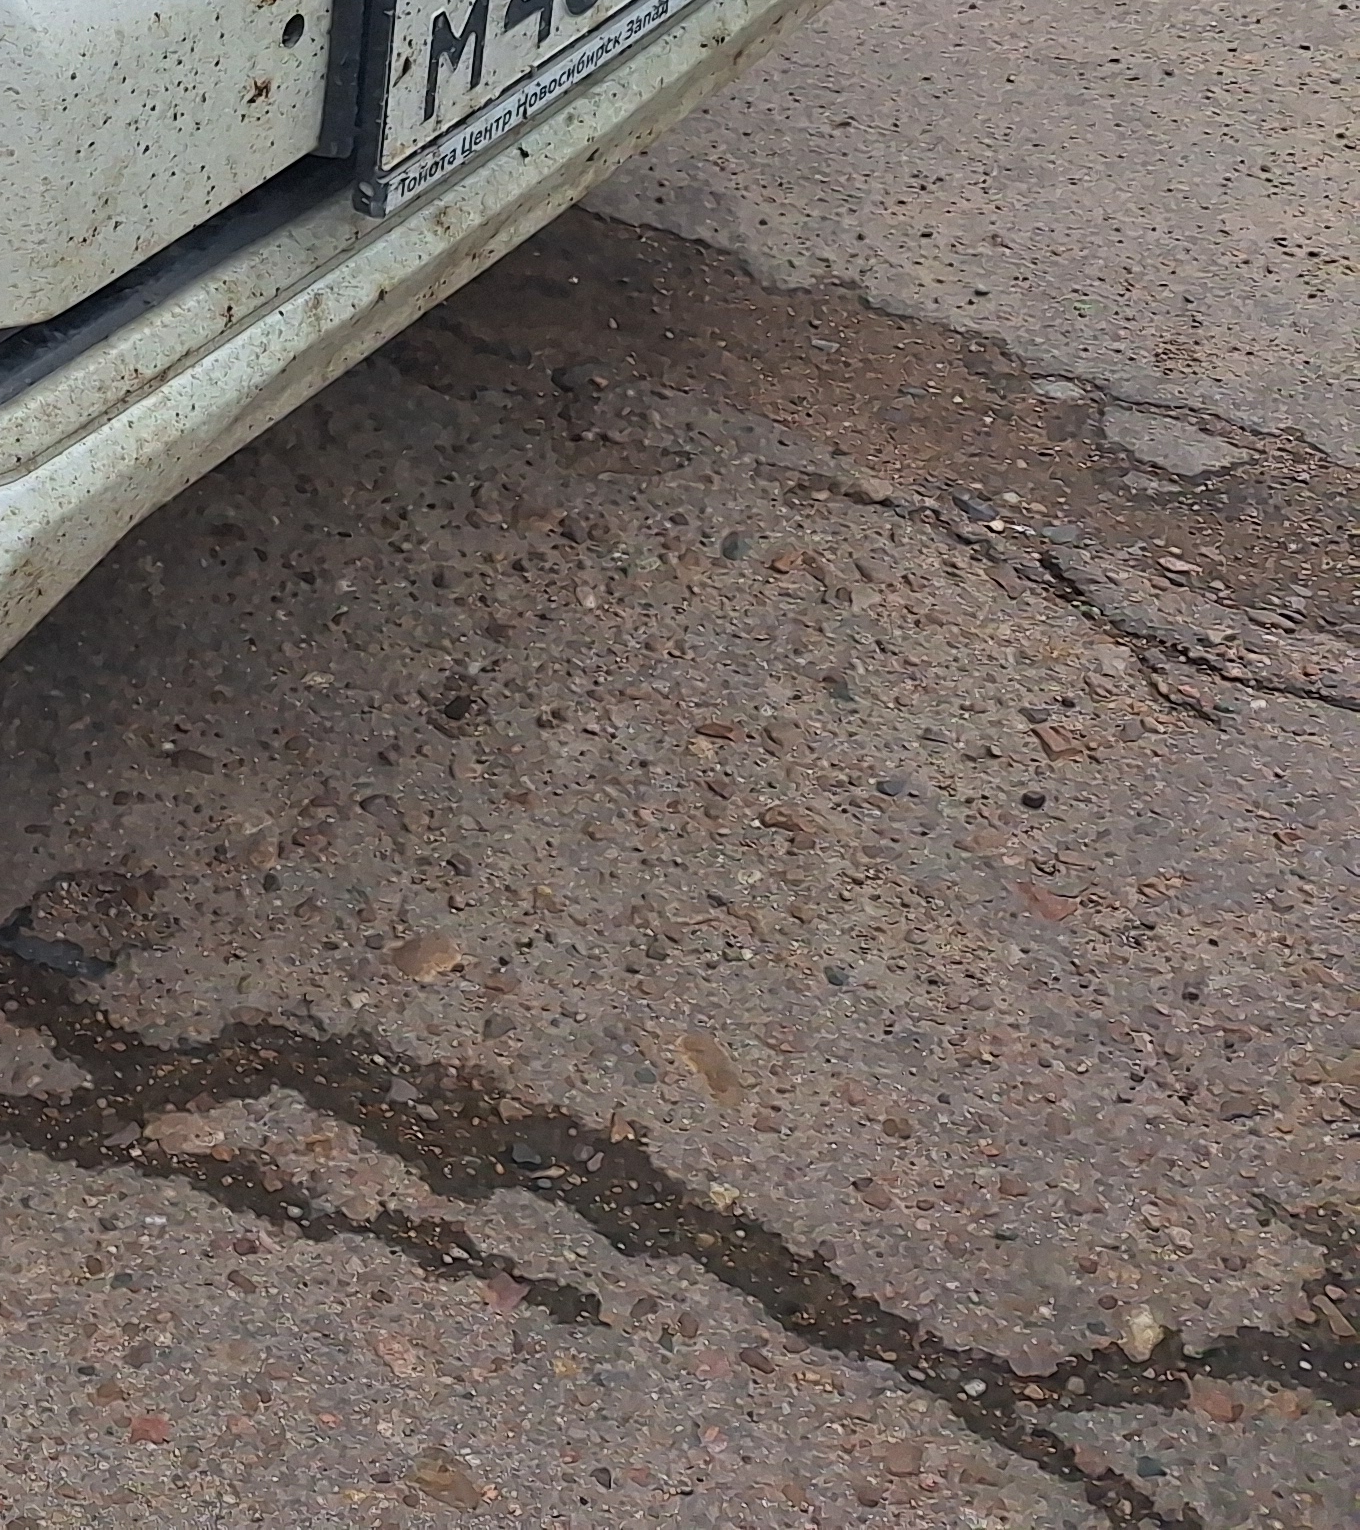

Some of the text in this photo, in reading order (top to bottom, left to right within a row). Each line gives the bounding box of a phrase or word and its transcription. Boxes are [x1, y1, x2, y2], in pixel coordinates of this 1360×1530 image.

[396, 150, 457, 197] Тойота
[460, 110, 512, 158] Центр
[515, 33, 622, 120] Новосибирск
[624, 0, 670, 41] Запад
